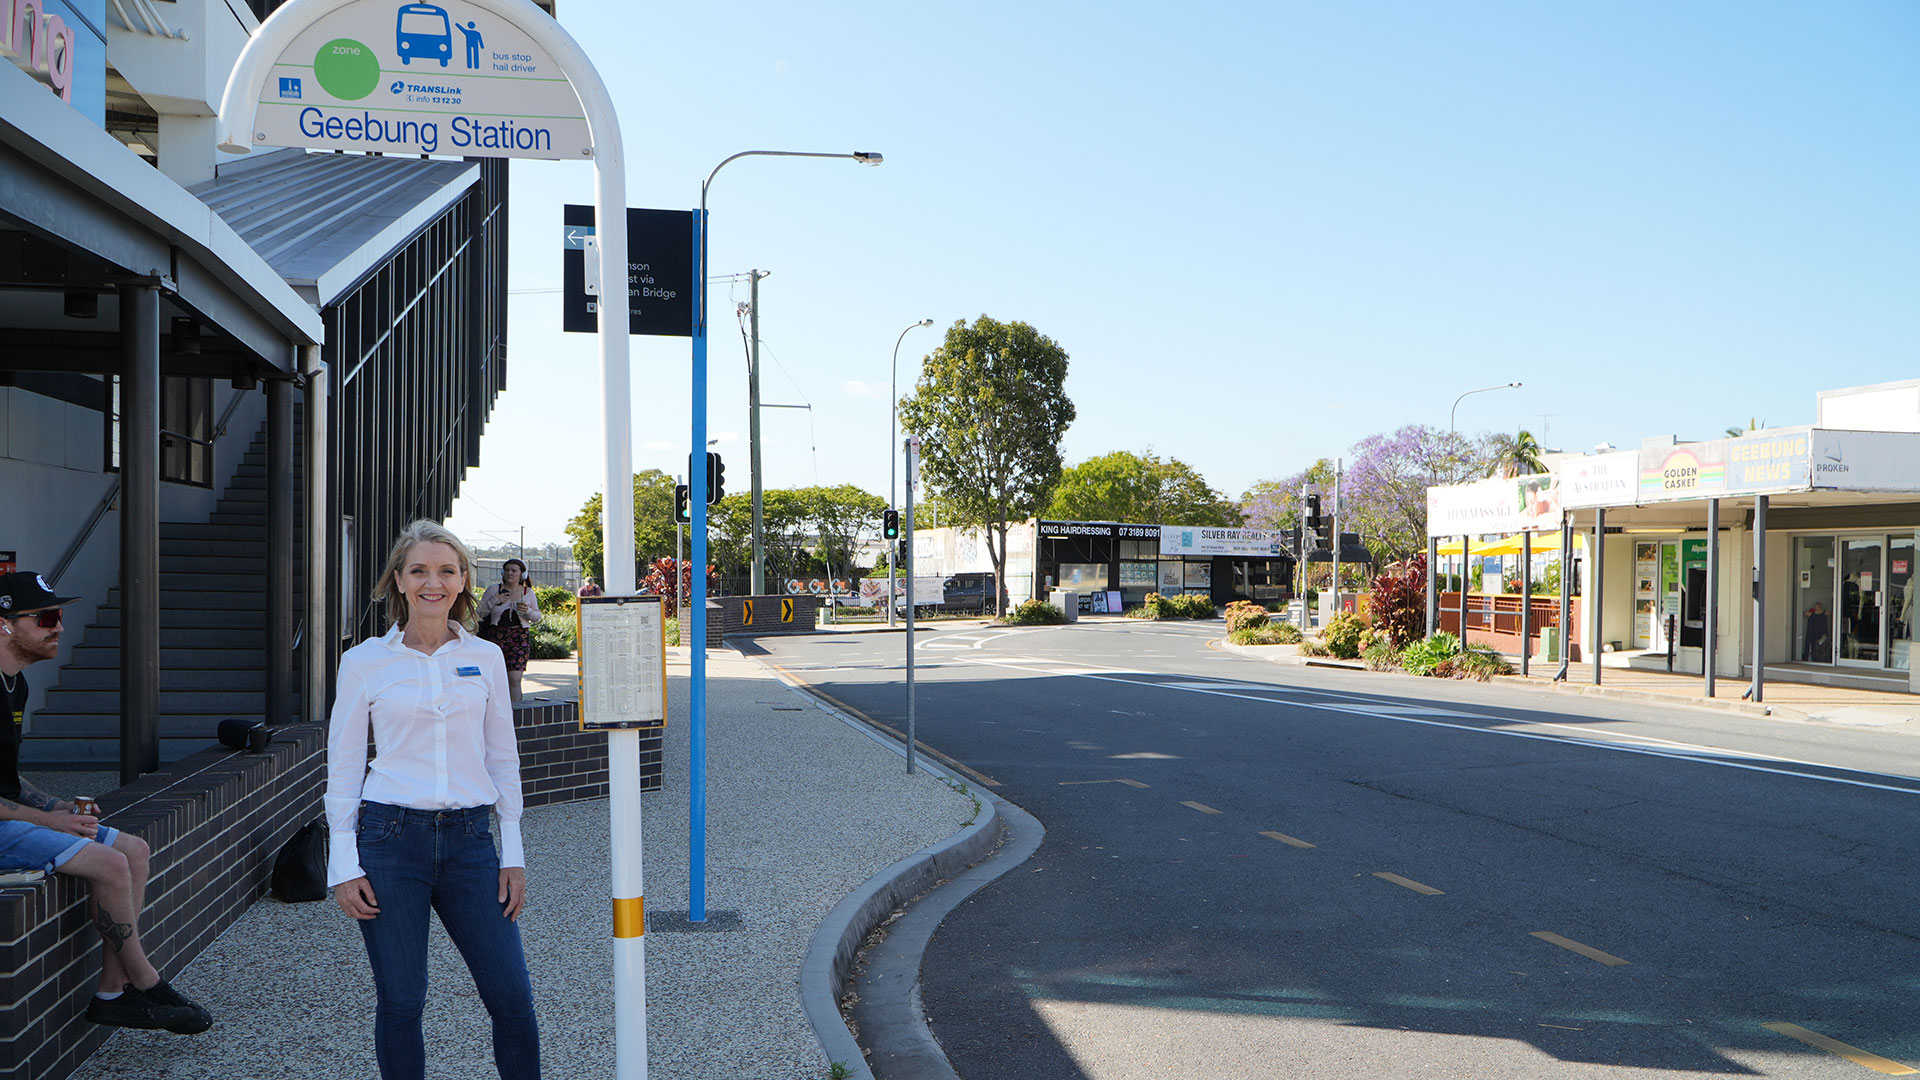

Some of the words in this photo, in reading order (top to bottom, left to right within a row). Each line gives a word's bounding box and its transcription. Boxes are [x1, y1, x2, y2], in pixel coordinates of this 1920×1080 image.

[332, 46, 361, 56] zone
[492, 52, 510, 61] bus
[511, 53, 532, 62] stop
[493, 63, 509, 71] hail
[511, 64, 537, 73] driver
[407, 84, 463, 95] TRANSLink
[416, 95, 431, 103] info
[299, 107, 438, 153] Geebung
[450, 116, 551, 150] Station
[628, 262, 650, 271] nson
[628, 274, 638, 283] st
[640, 274, 655, 284] via
[642, 287, 677, 300] Bridge
[1731, 438, 1807, 463] GEEBUNG
[1593, 465, 1608, 475] THE
[1664, 467, 1697, 478] GOLDEN
[1744, 463, 1791, 482] NEWS
[1816, 464, 1849, 473] BROKEN
[1573, 480, 1626, 493] AUSTRALIAN
[1664, 478, 1697, 489] CASKET
[1040, 525, 1059, 534] KING
[1060, 526, 1112, 536] HAIRDRESSING
[1118, 527, 1127, 536] 07
[1128, 528, 1144, 536] 3189
[1144, 528, 1160, 537] 8091
[1201, 530, 1227, 540] SILVER
[1228, 531, 1241, 540] RAY
